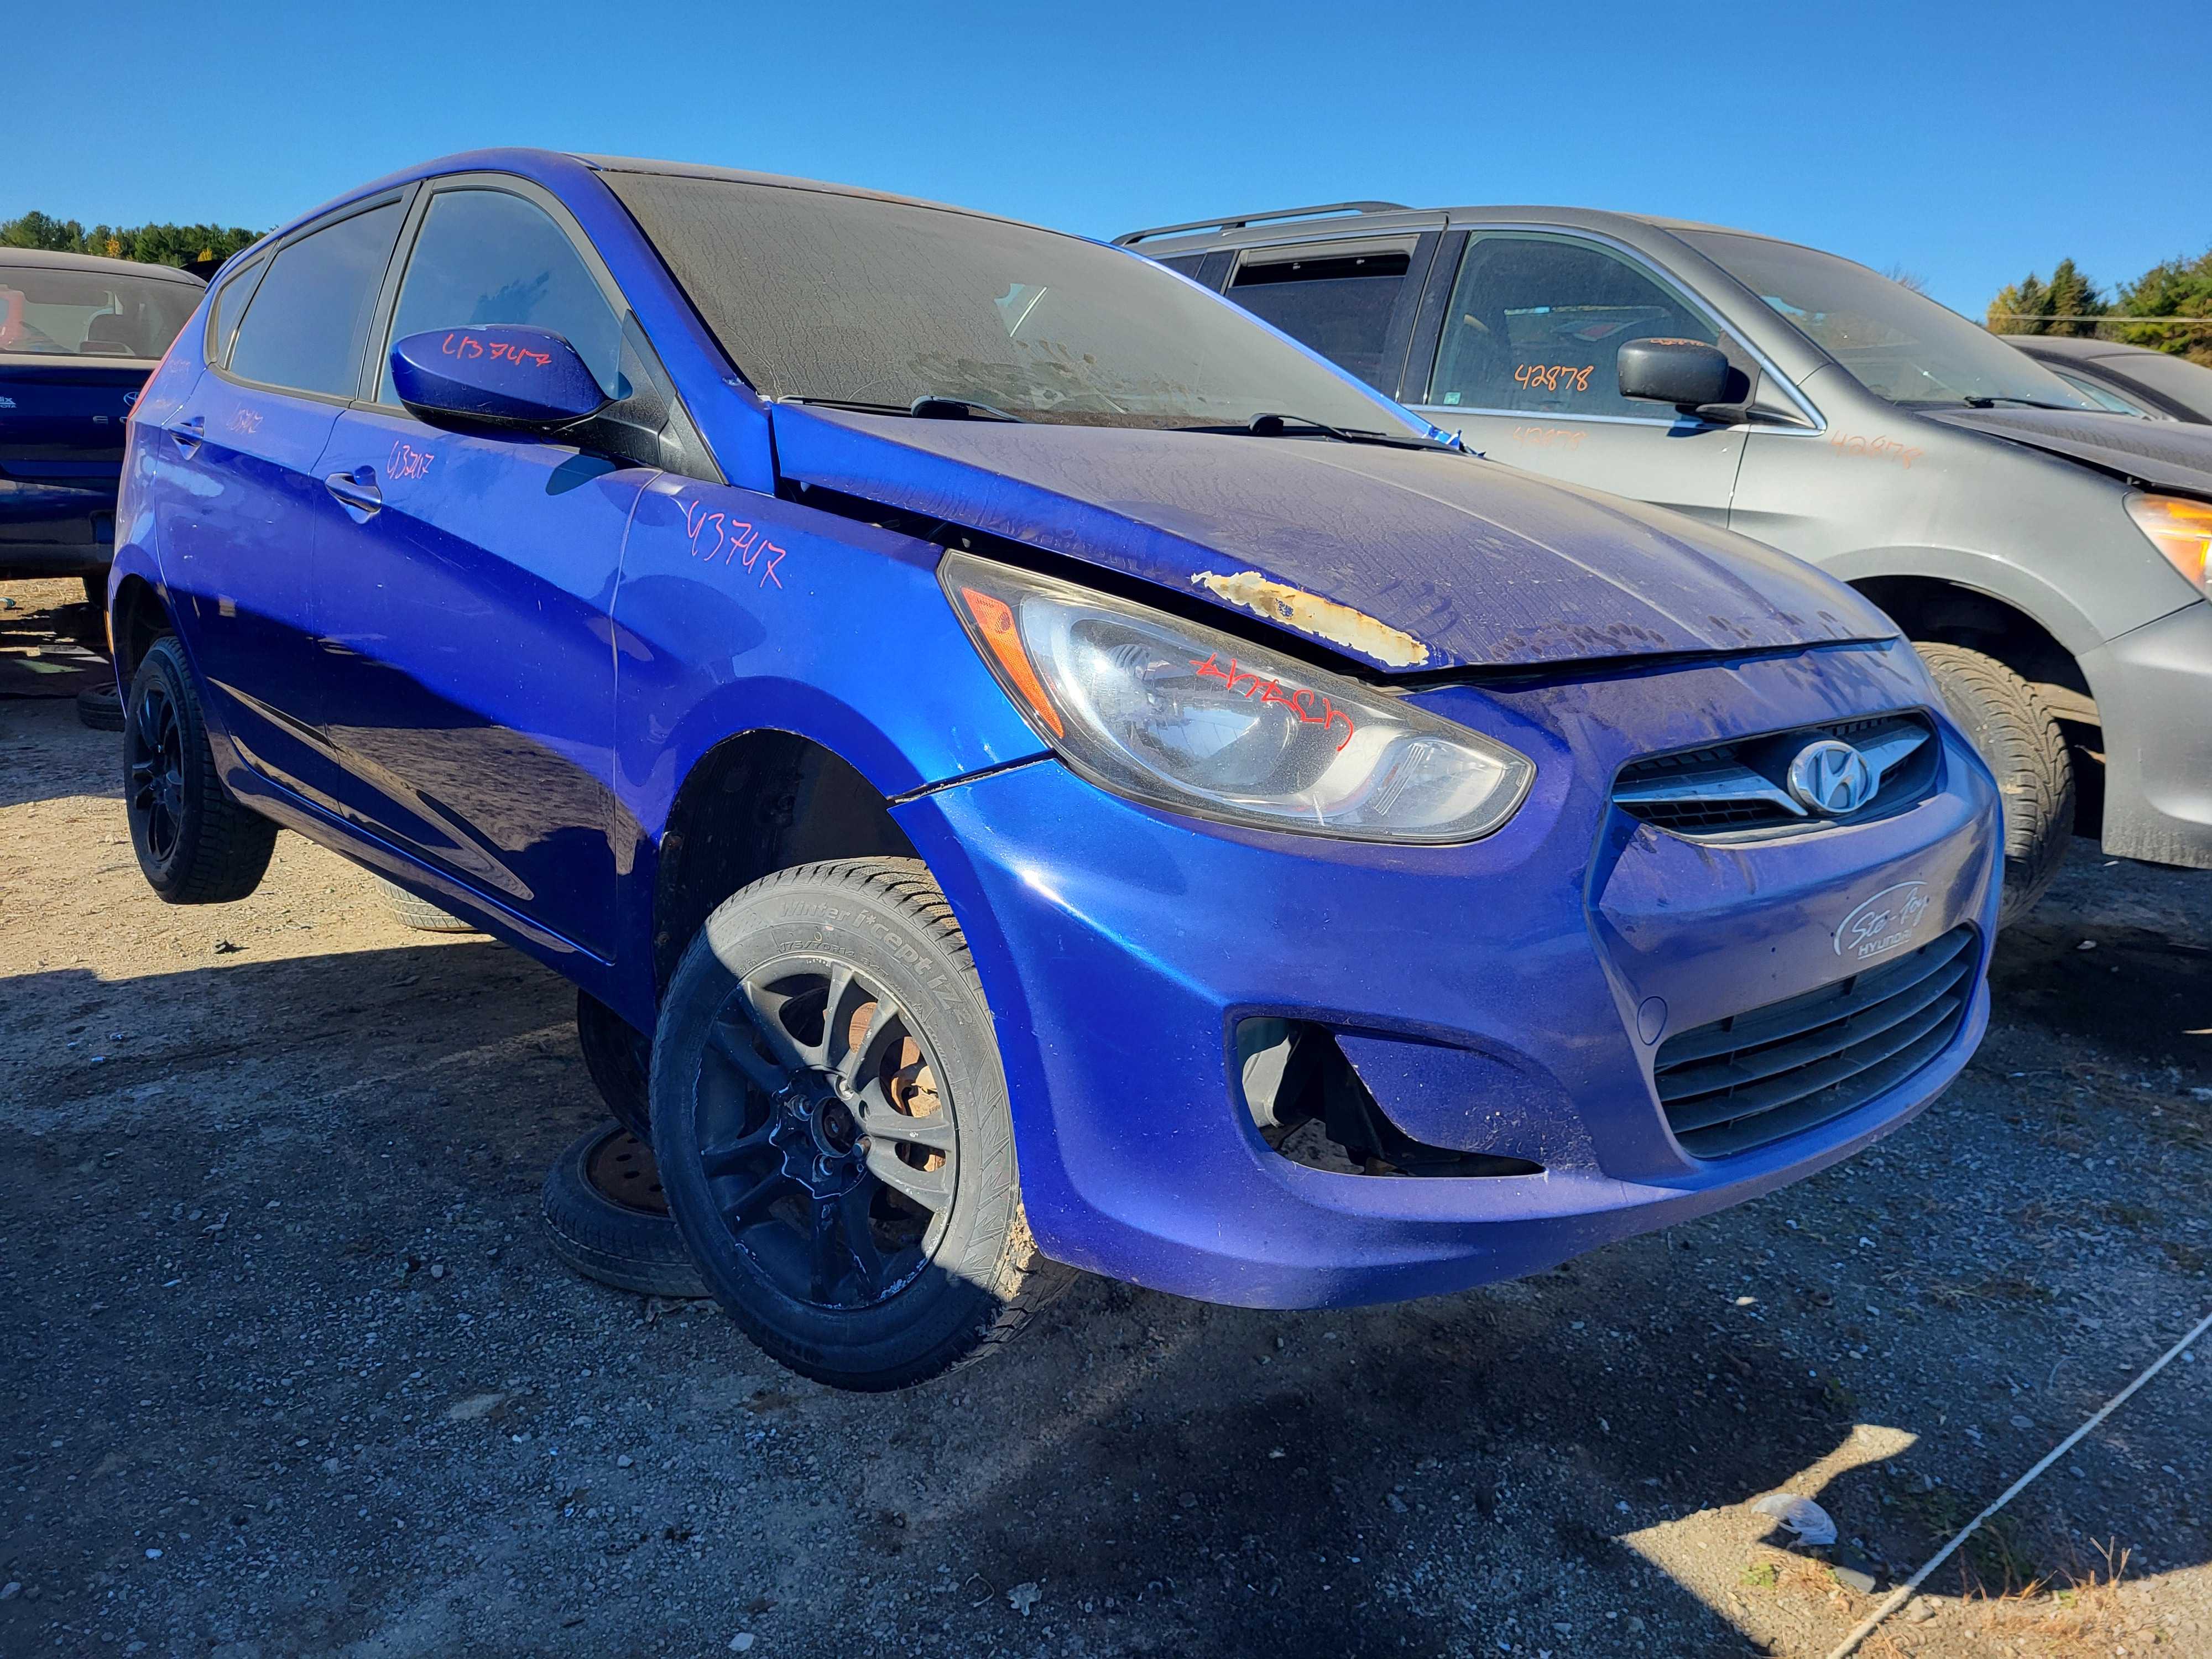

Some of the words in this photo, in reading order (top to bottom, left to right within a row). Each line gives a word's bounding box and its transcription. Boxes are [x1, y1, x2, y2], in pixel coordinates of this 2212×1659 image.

[443, 333, 551, 367] 43747
[1514, 363, 1594, 392] 42878
[687, 500, 786, 589] 43747
[780, 900, 851, 921] Winter
